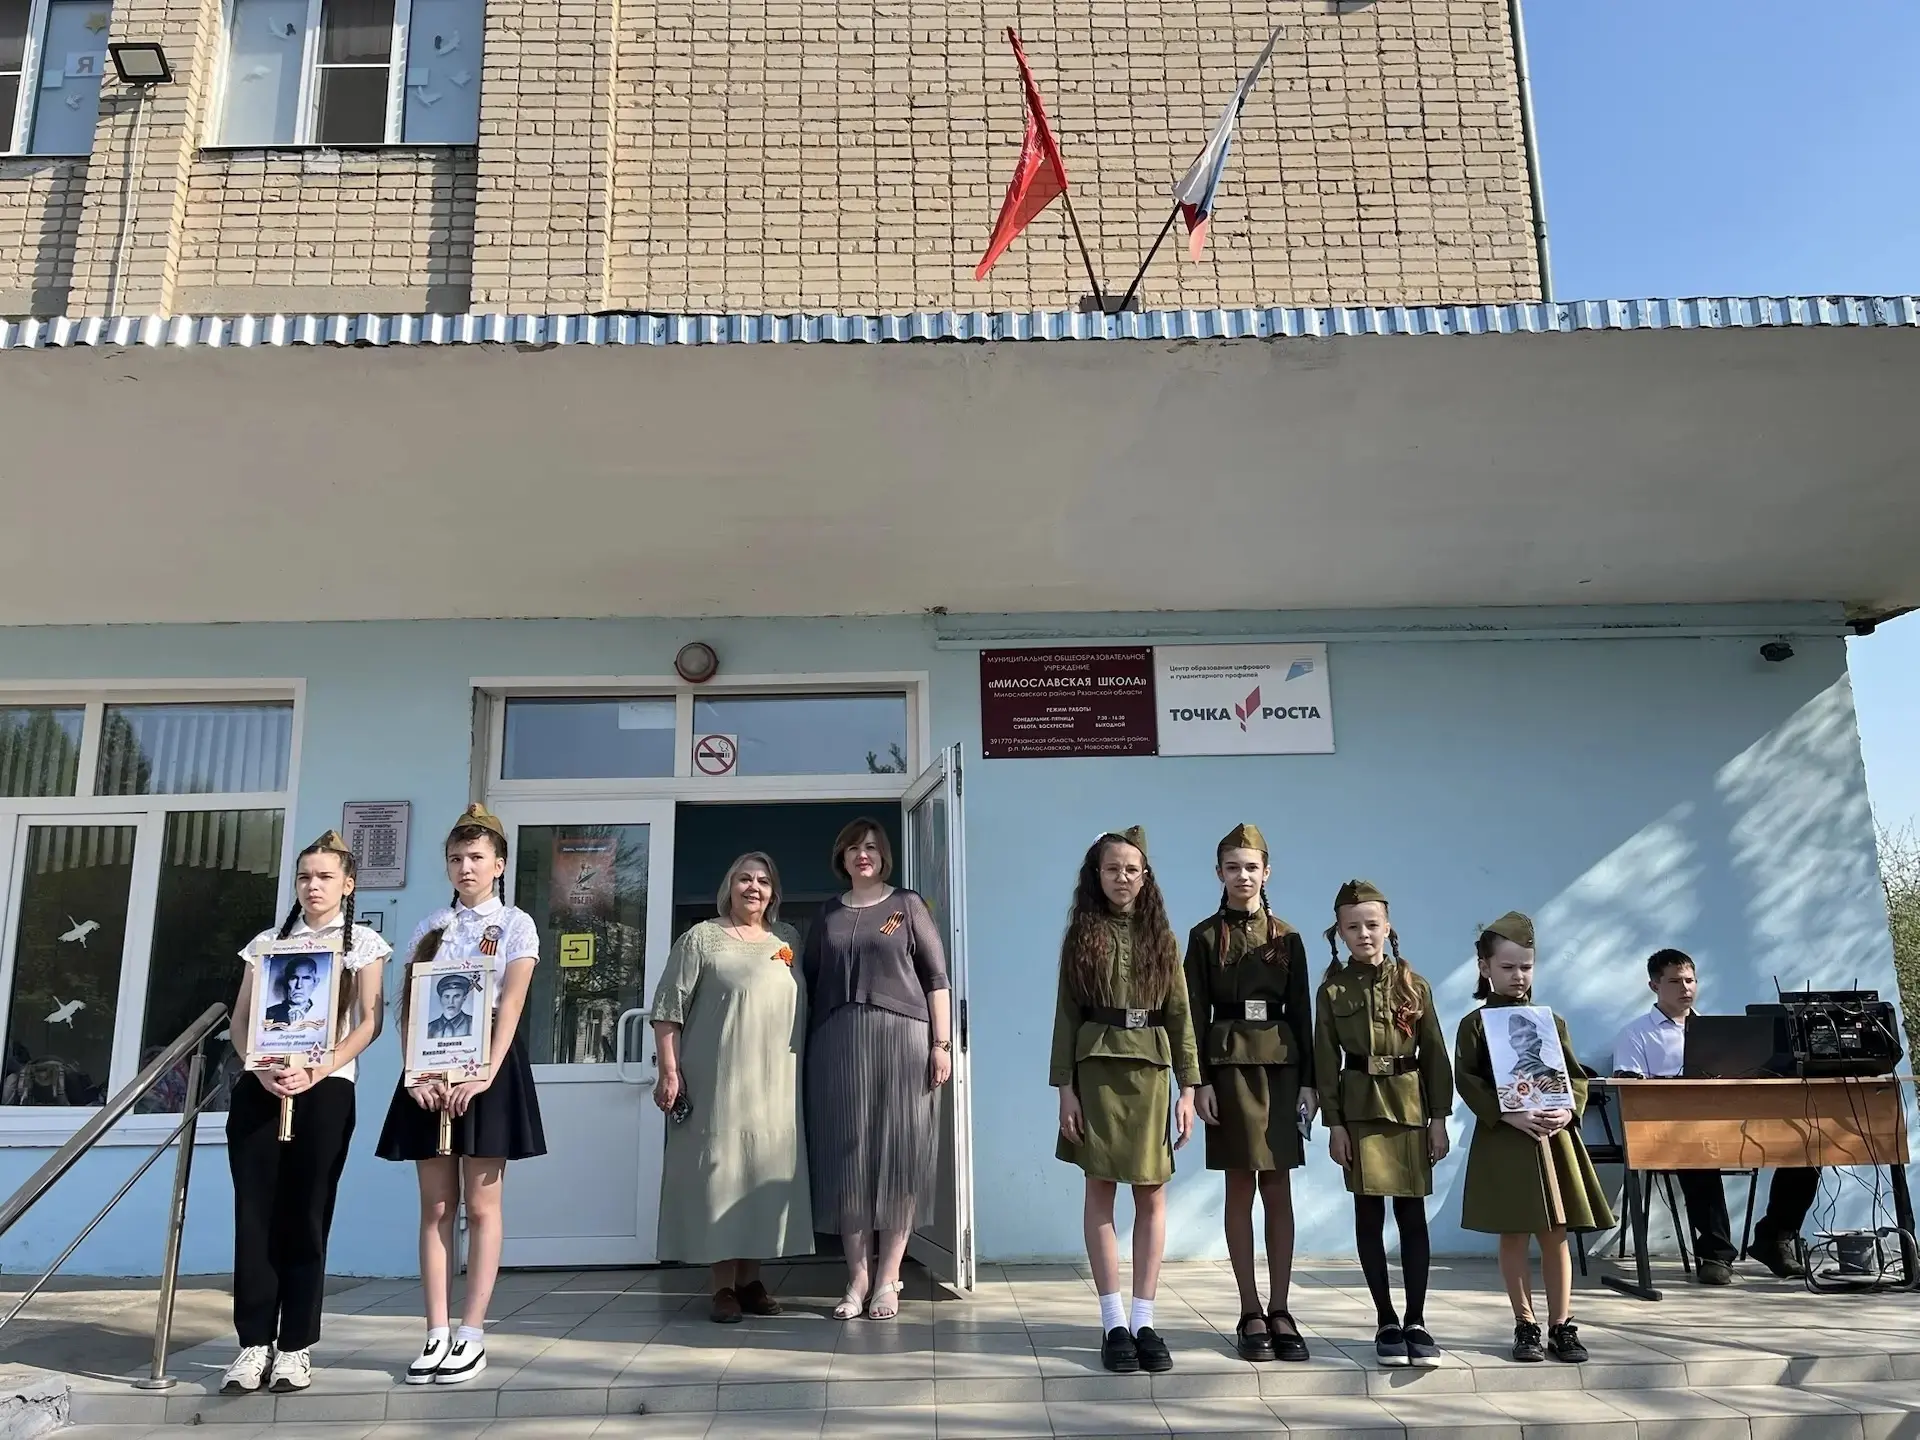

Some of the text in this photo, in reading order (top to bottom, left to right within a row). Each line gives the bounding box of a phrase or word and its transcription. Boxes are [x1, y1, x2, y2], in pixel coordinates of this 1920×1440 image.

[989, 676, 1146, 689] «МИЛОСЛАВСКАЯ ШКОЛА»
[1170, 706, 1321, 721] ТОЧКА РОСТА
